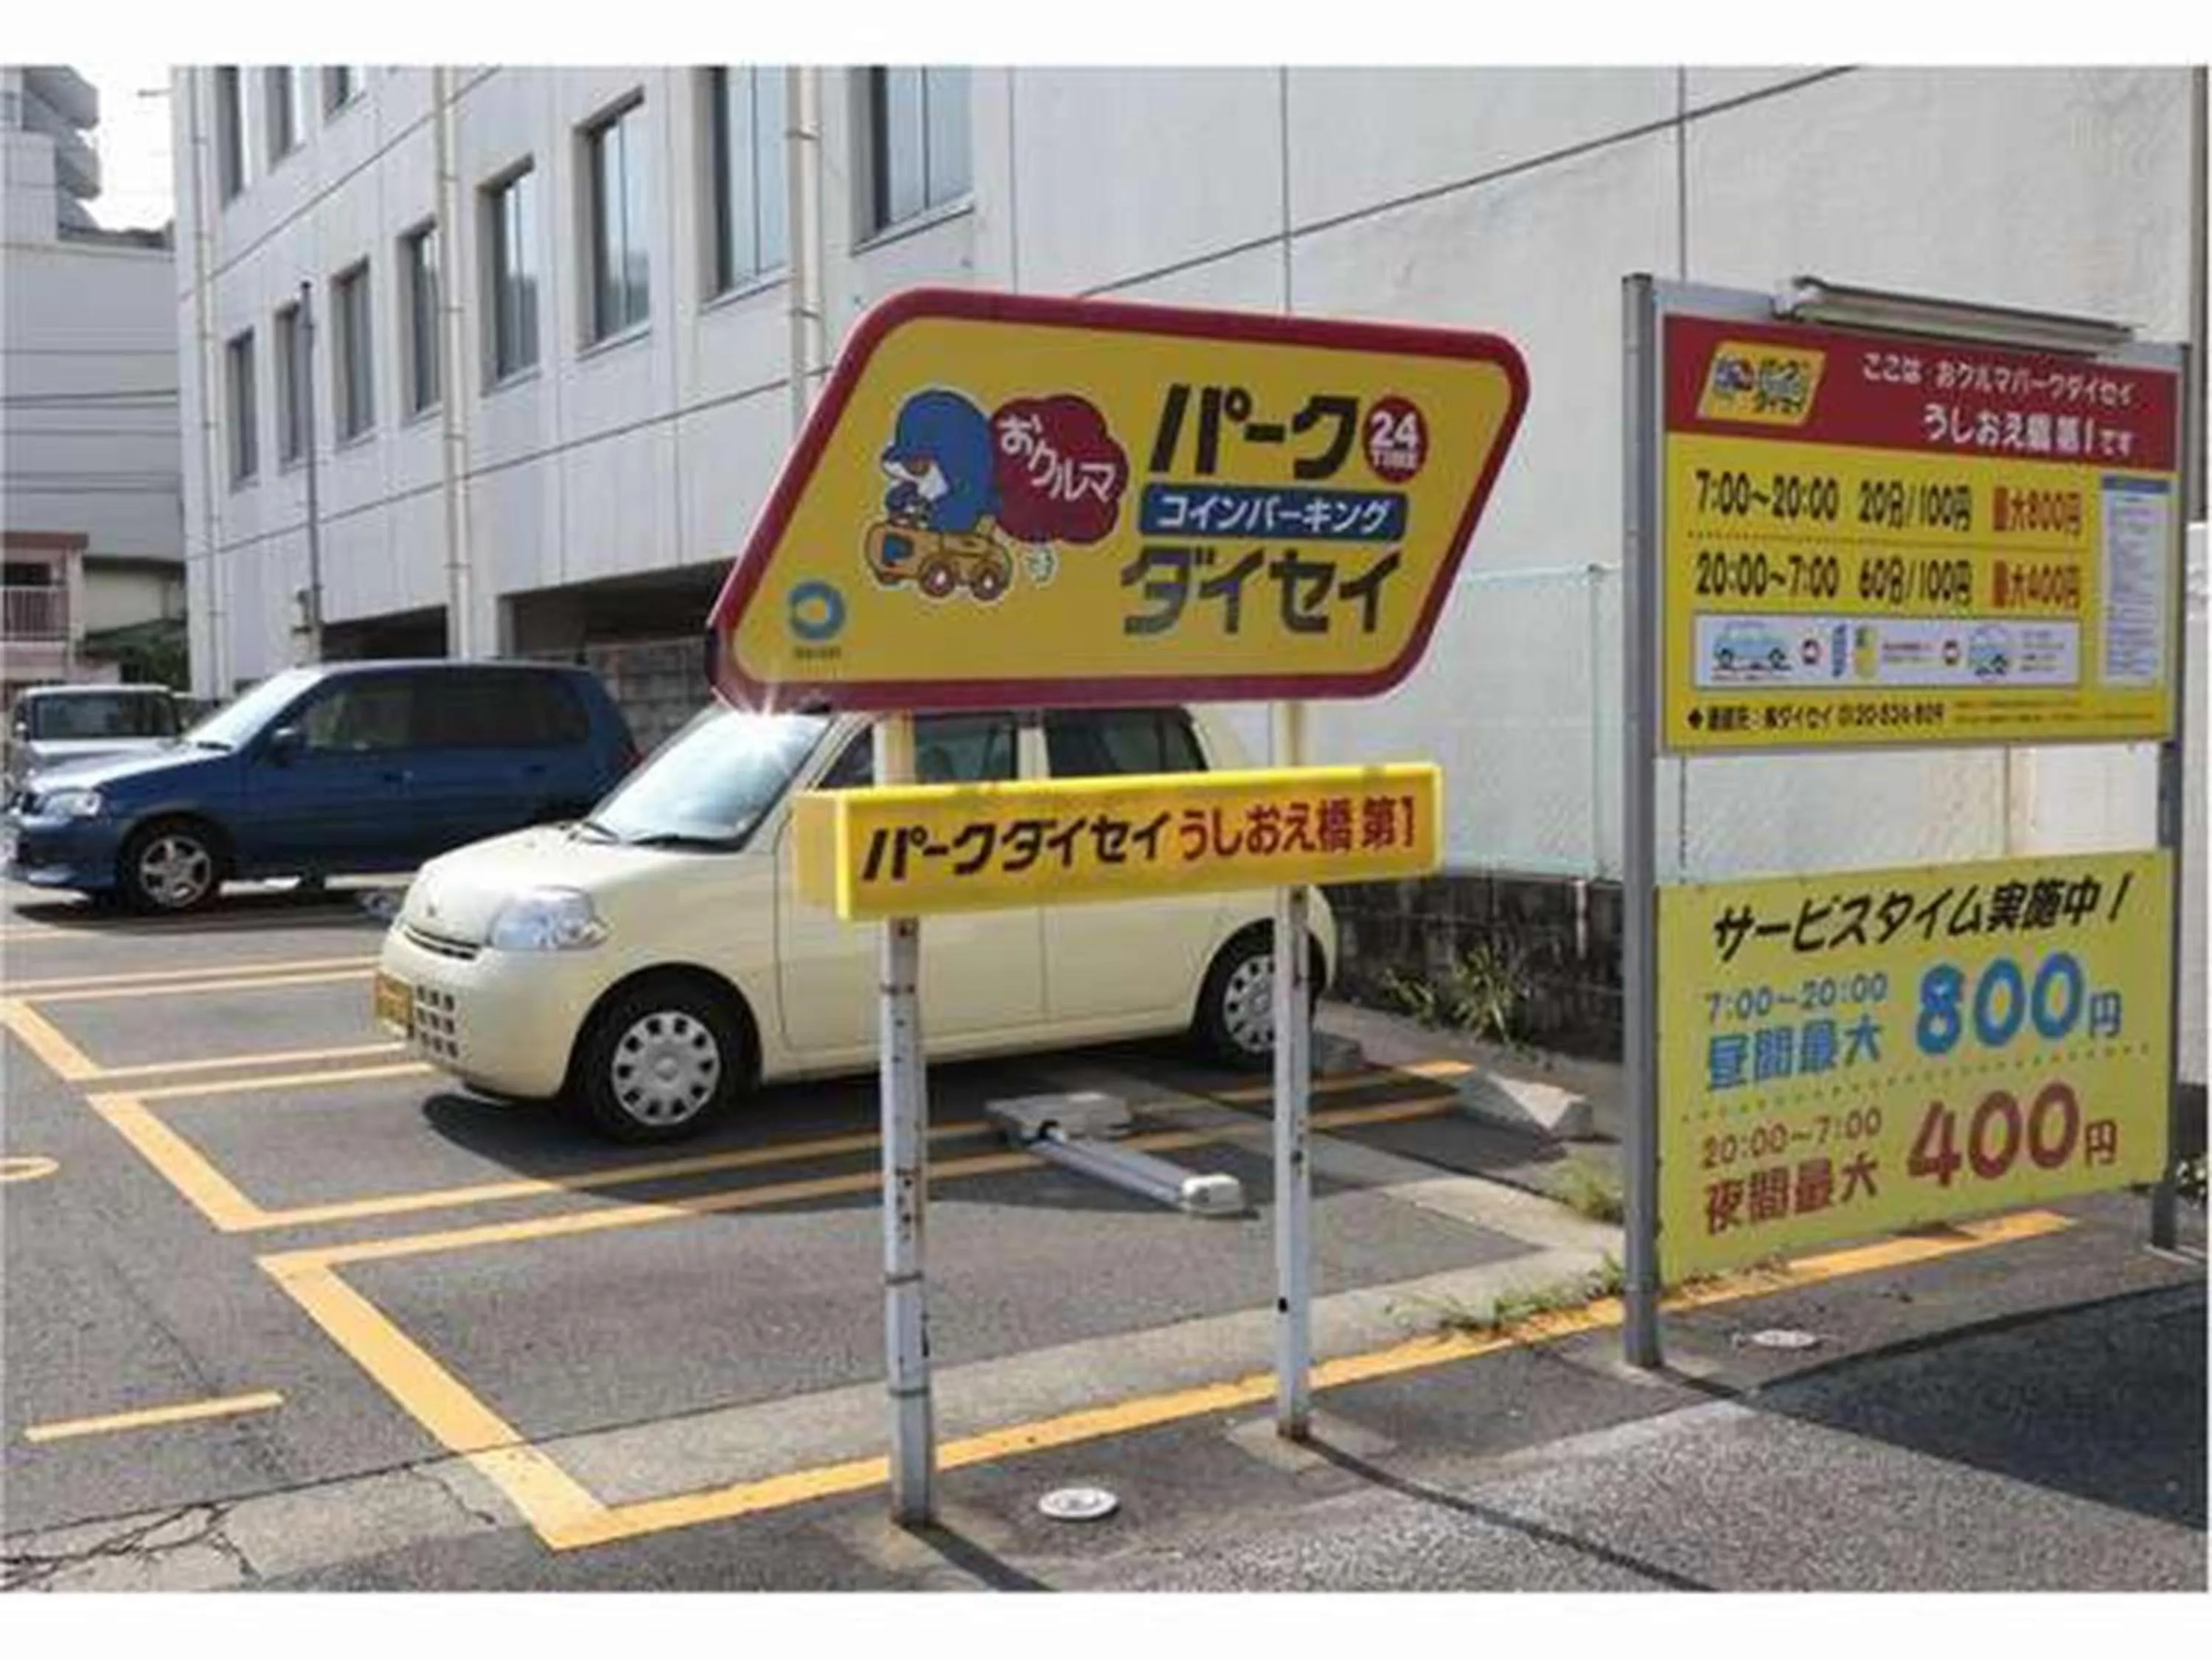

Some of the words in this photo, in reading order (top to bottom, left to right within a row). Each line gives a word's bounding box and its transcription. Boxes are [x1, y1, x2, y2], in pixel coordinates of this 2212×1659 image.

[997, 414, 1117, 503] おクルマ
[1149, 383, 1360, 479] パーク
[1370, 410, 1419, 448] 24
[1157, 494, 1392, 533] コインパーキング
[1121, 546, 1402, 634] ダイセイ
[862, 813, 1172, 882] パークダイセイ
[1706, 1014, 1882, 1091] 昼間最大
[1917, 951, 2122, 1054] 800円
[1705, 1152, 1879, 1234] 夜間最大
[1907, 1082, 2118, 1187] 400円
